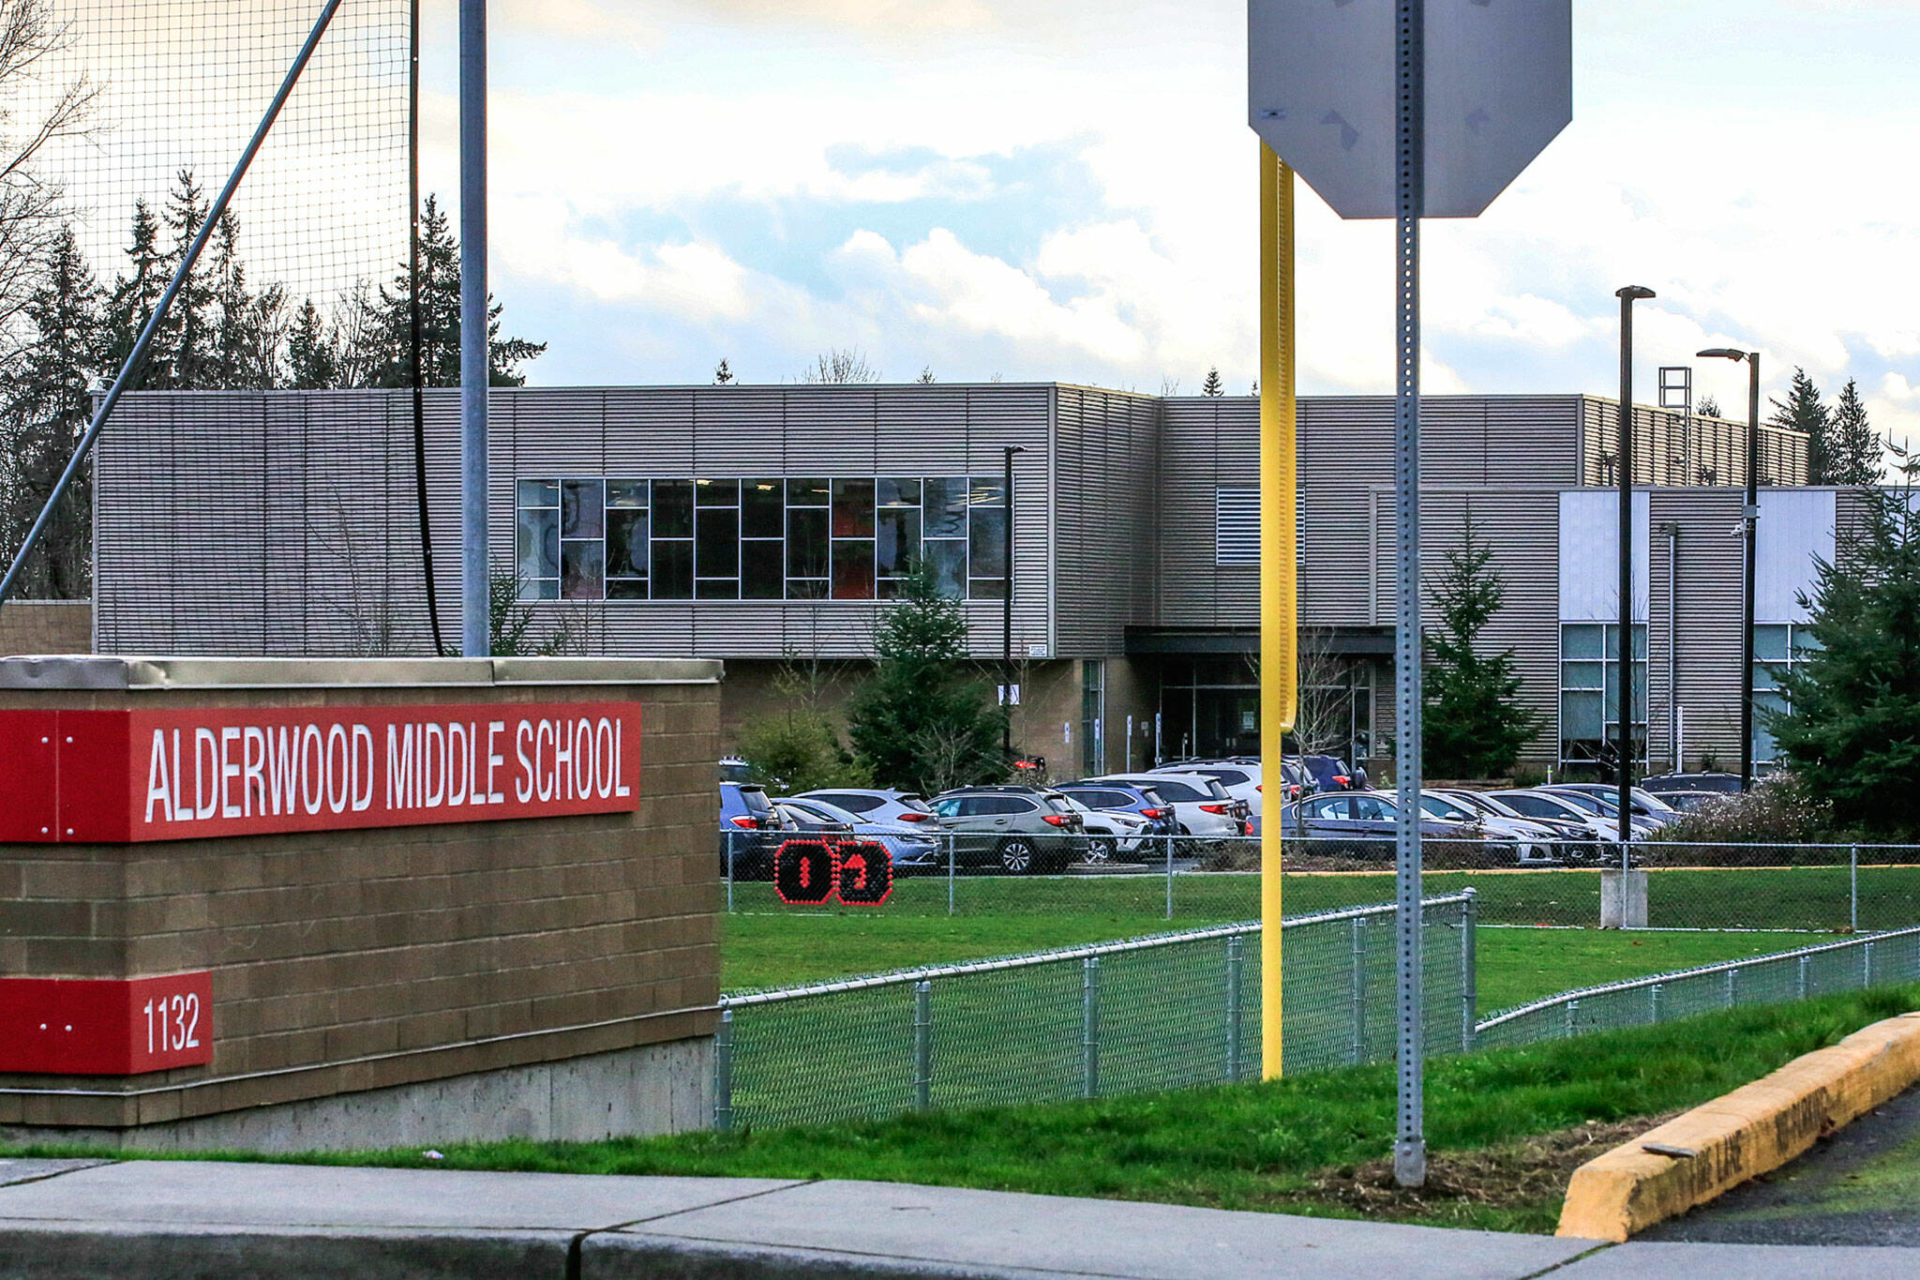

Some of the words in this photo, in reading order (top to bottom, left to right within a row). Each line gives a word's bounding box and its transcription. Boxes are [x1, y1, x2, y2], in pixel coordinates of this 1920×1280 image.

[144, 723, 374, 823] ALDERWOOD
[386, 721, 505, 810] MIDDLE
[515, 717, 630, 804] SCHOOL
[144, 993, 200, 1053] 1132
[1715, 1129, 1743, 1183] LANE
